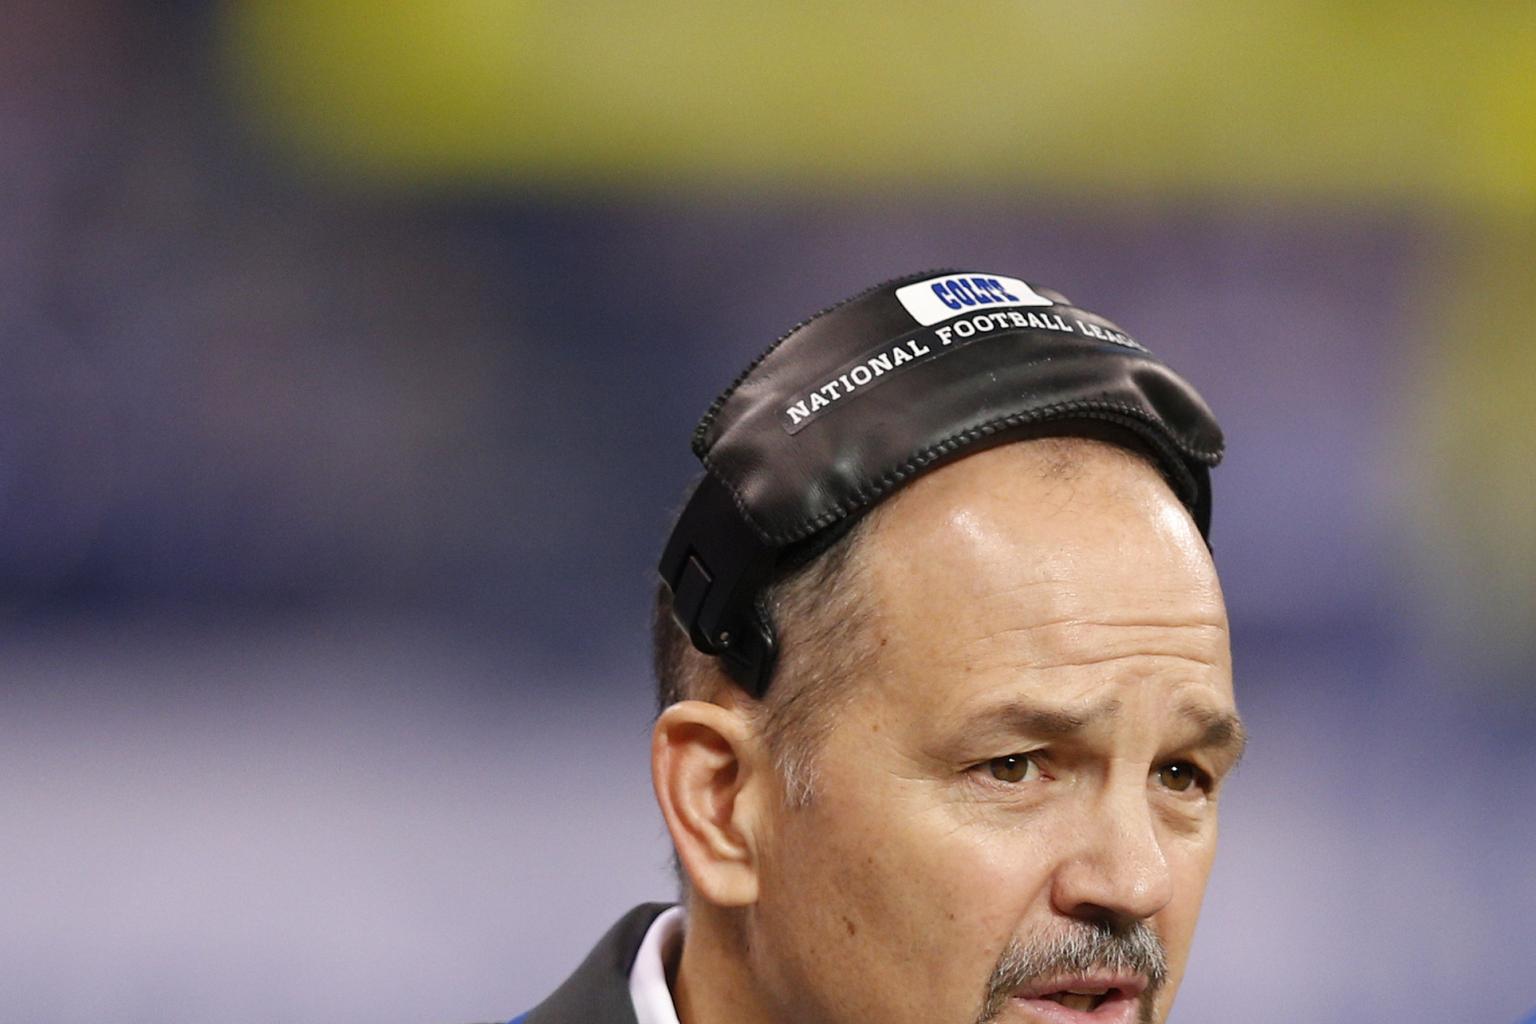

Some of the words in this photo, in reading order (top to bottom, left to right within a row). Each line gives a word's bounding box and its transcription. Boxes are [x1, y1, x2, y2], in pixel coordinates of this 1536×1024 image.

[930, 277, 1020, 310] COLTS
[786, 339, 930, 426] NATIONAL
[935, 311, 1074, 345] FOOTBALL
[1075, 320, 1151, 353] LEAG
